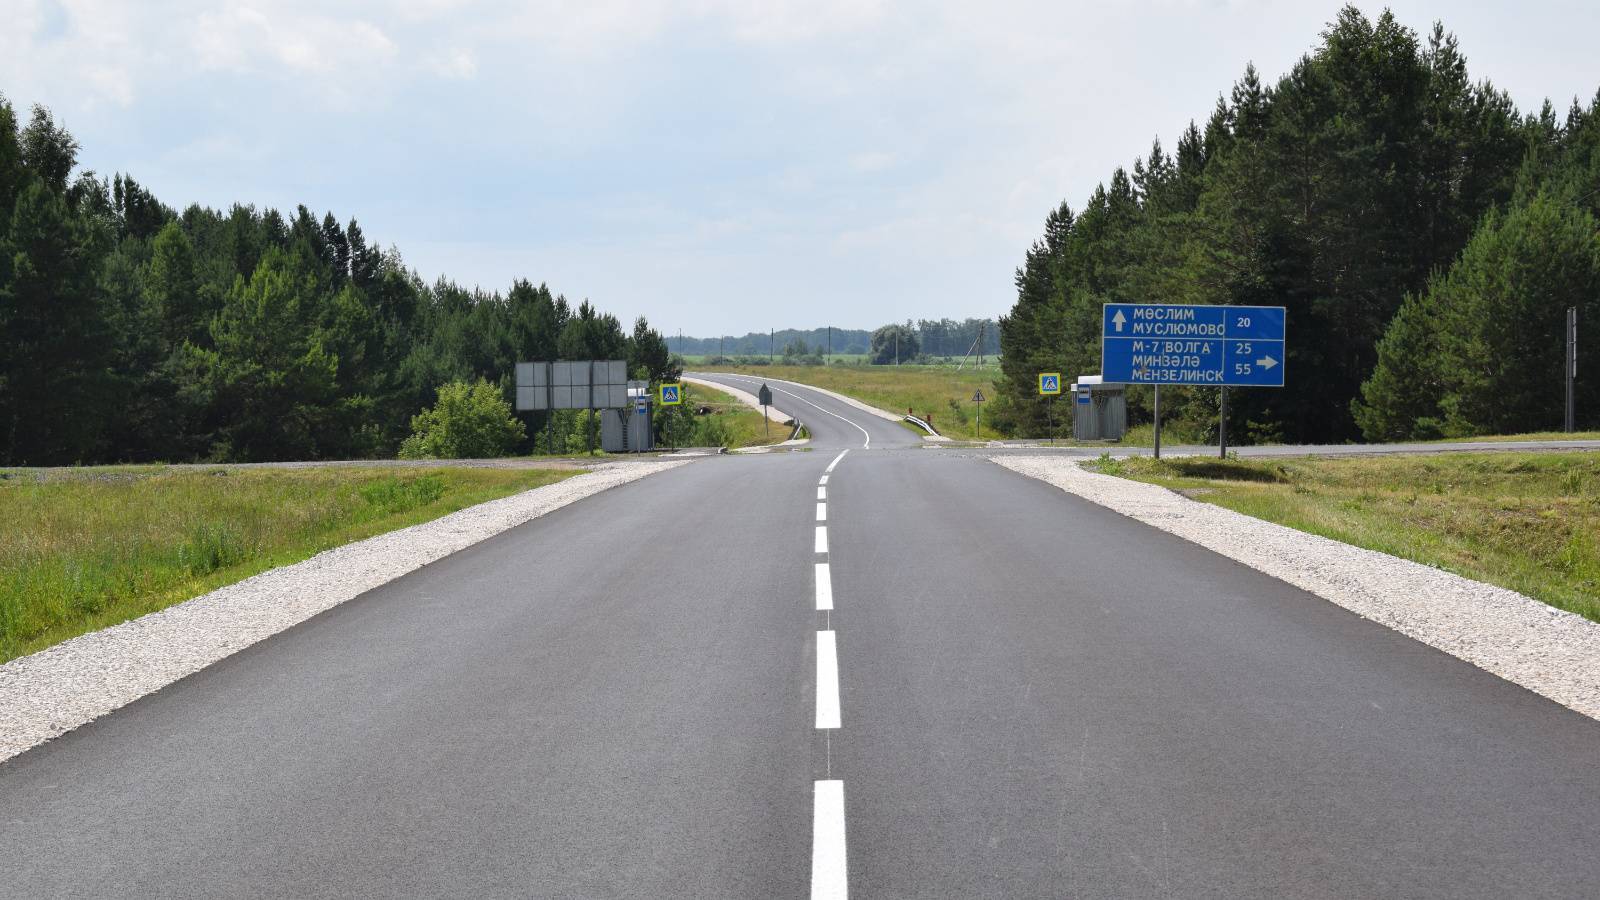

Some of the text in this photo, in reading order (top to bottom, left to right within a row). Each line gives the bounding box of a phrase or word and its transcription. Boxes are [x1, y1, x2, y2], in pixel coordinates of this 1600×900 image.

[1133, 308, 1195, 320] МӨСЛИМ
[1236, 317, 1251, 327] 20
[1132, 323, 1226, 335] МУСЛЮМОВО
[1235, 343, 1252, 354] 25
[1132, 355, 1200, 368] МИНЗӘЛӘ
[1235, 363, 1251, 375] 55
[1131, 369, 1224, 382] МЕНЗЕЛИНСК
